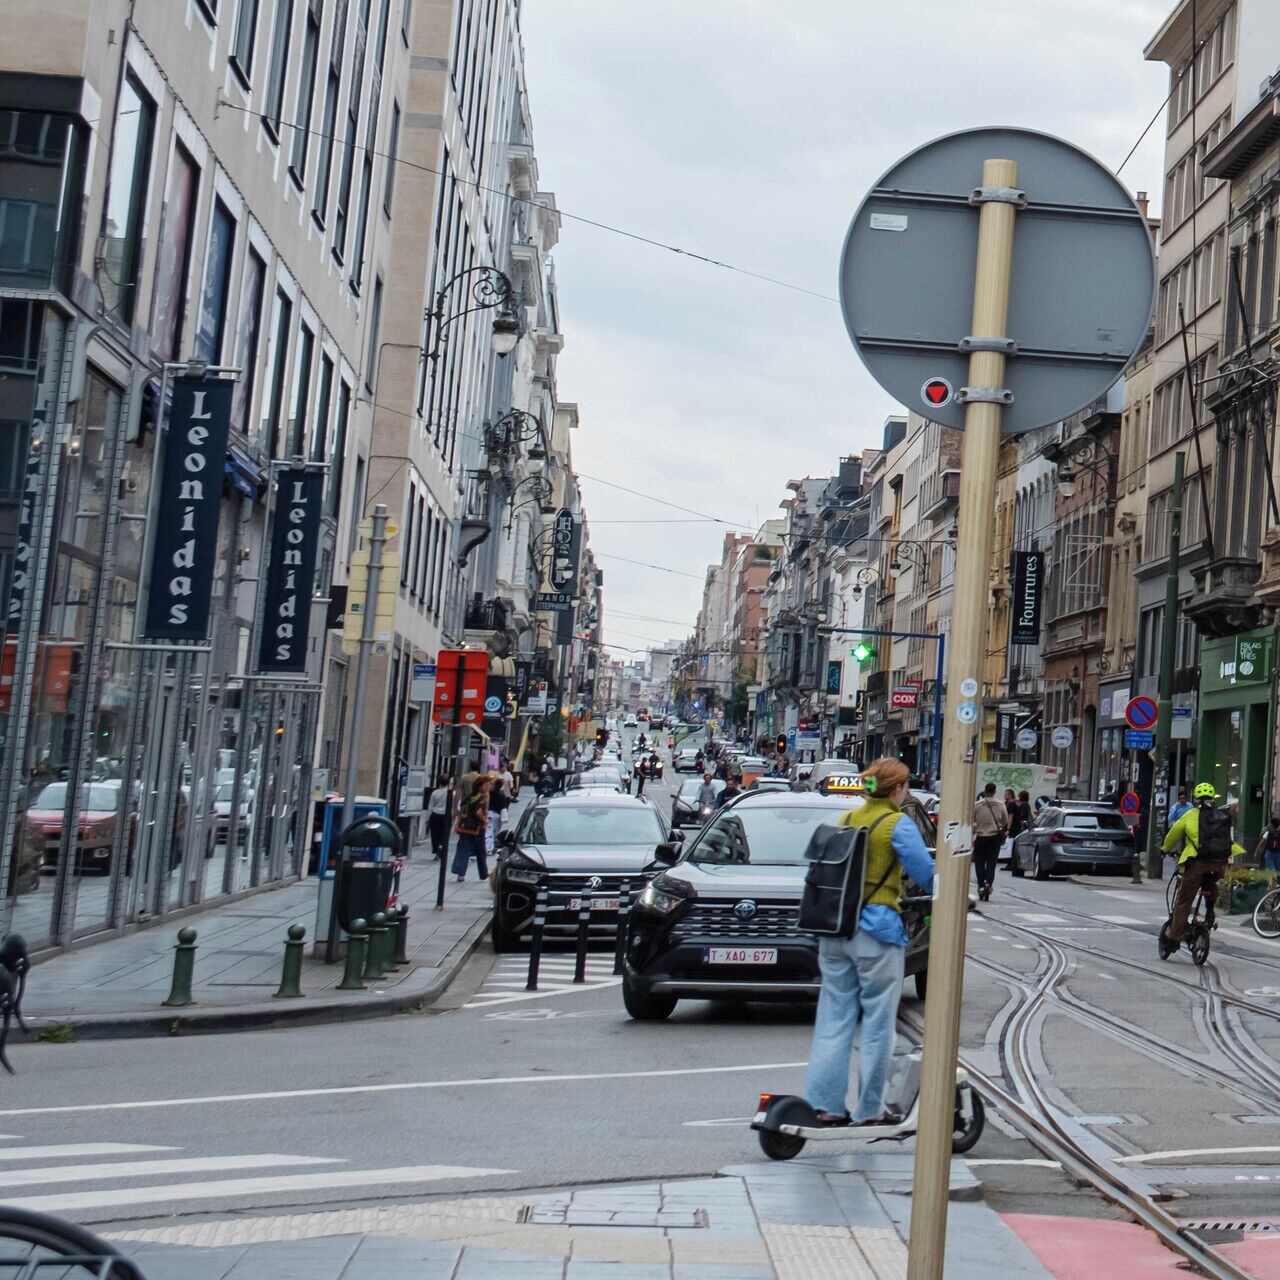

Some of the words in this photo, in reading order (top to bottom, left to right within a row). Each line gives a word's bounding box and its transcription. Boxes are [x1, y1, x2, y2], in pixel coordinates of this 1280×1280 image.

[168, 391, 212, 624] Leonidas
[275, 481, 308, 660] Leonidas
[1019, 555, 1038, 627] Fourrures
[893, 694, 916, 704] COX
[833, 776, 862, 787] TAXI
